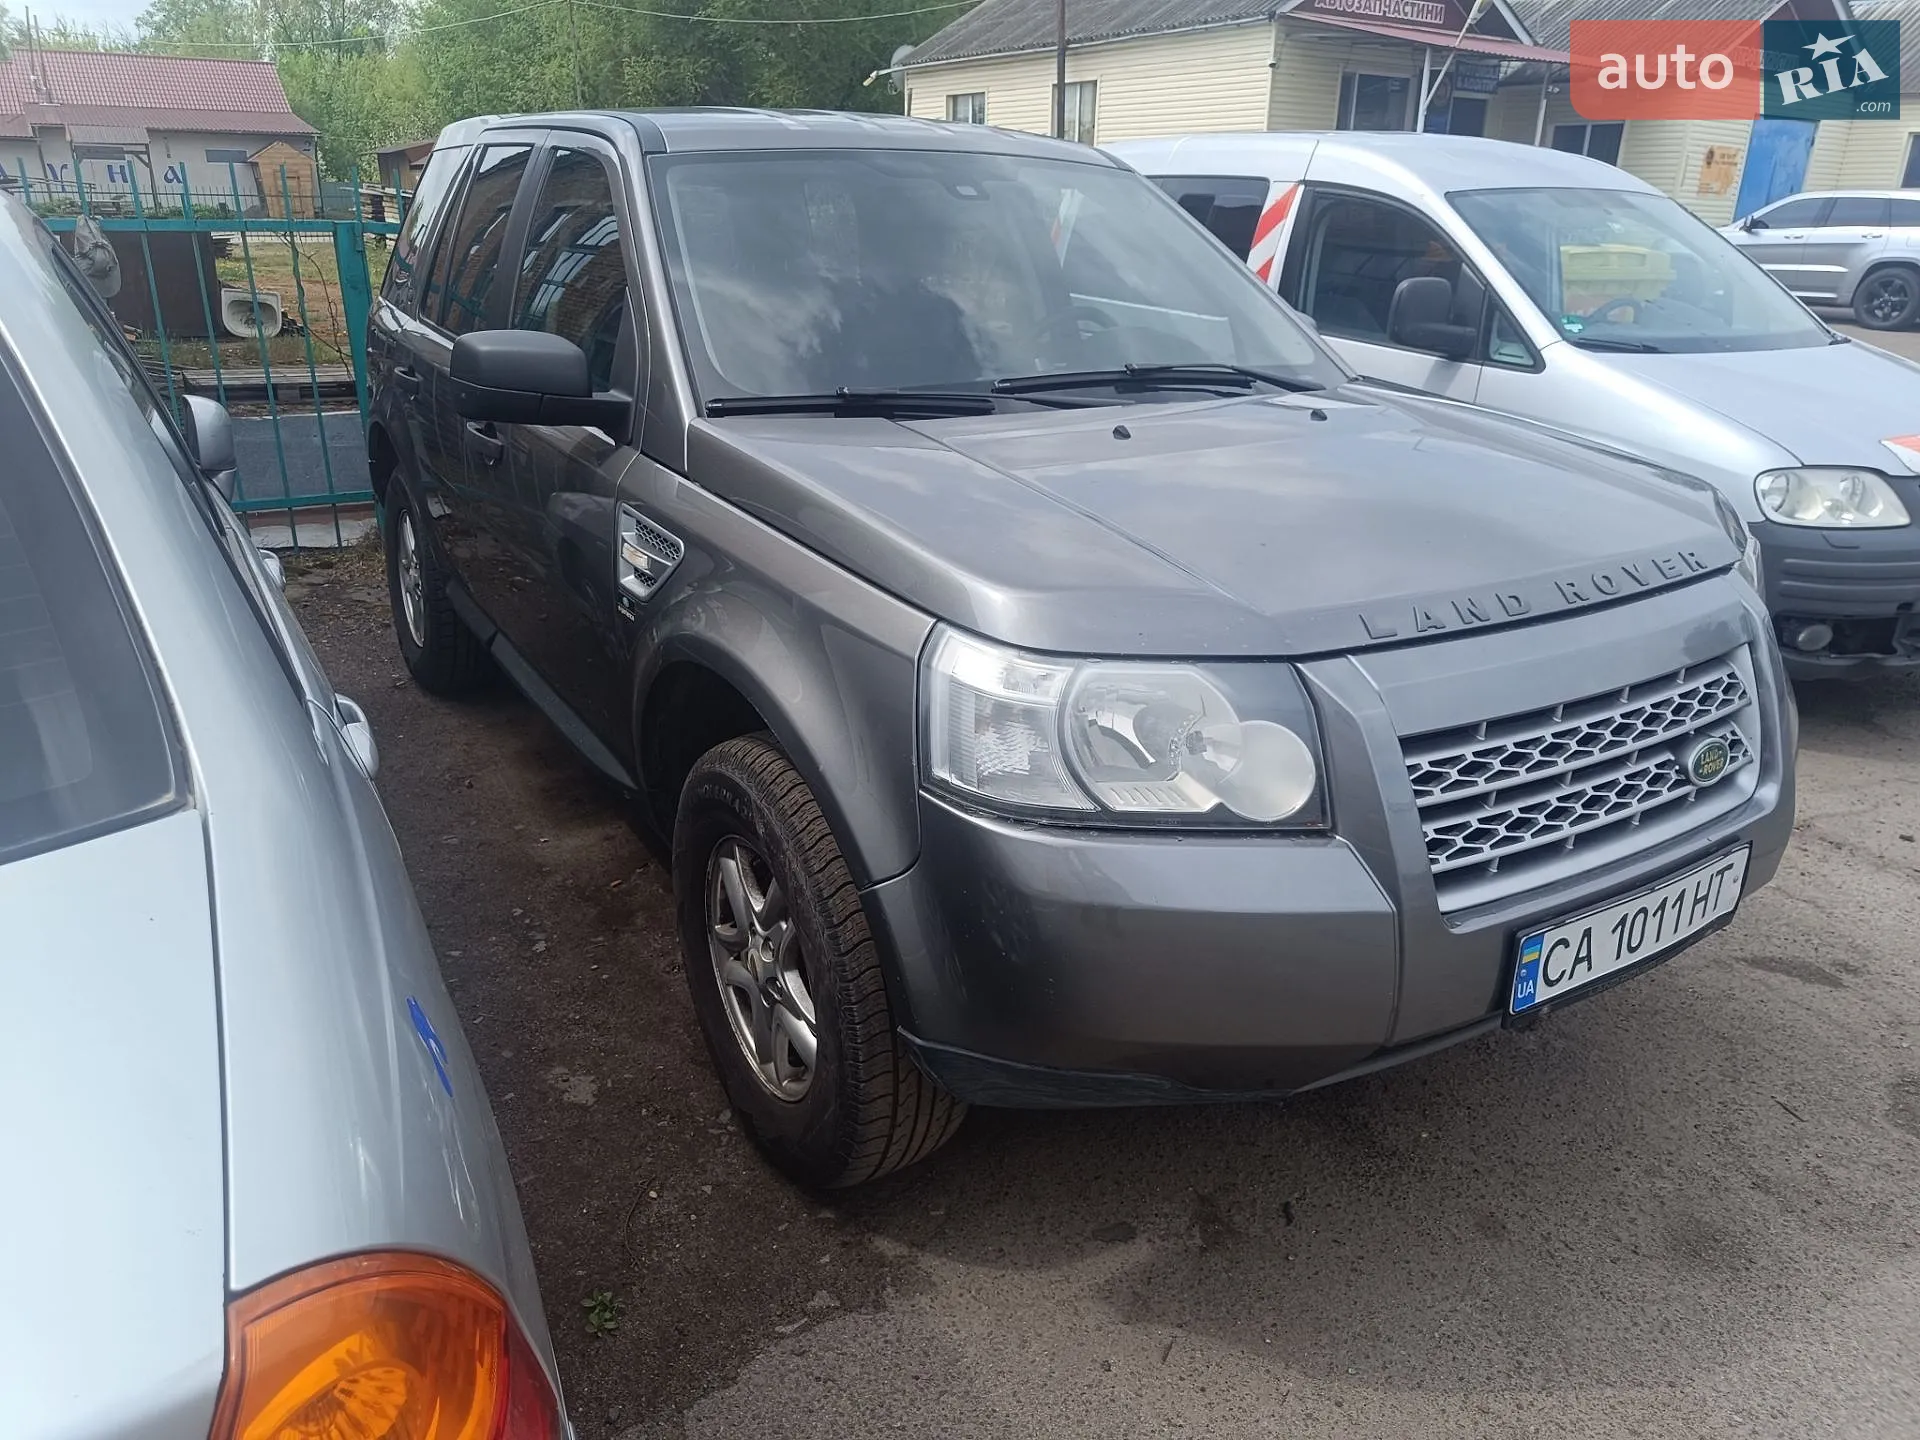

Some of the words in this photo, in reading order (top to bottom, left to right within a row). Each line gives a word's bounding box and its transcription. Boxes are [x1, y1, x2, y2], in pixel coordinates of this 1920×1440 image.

[1359, 593, 1531, 639] LAND
[1555, 550, 1708, 604] ROVER
[1542, 926, 1593, 988] CA
[1517, 979, 1535, 999] UA
